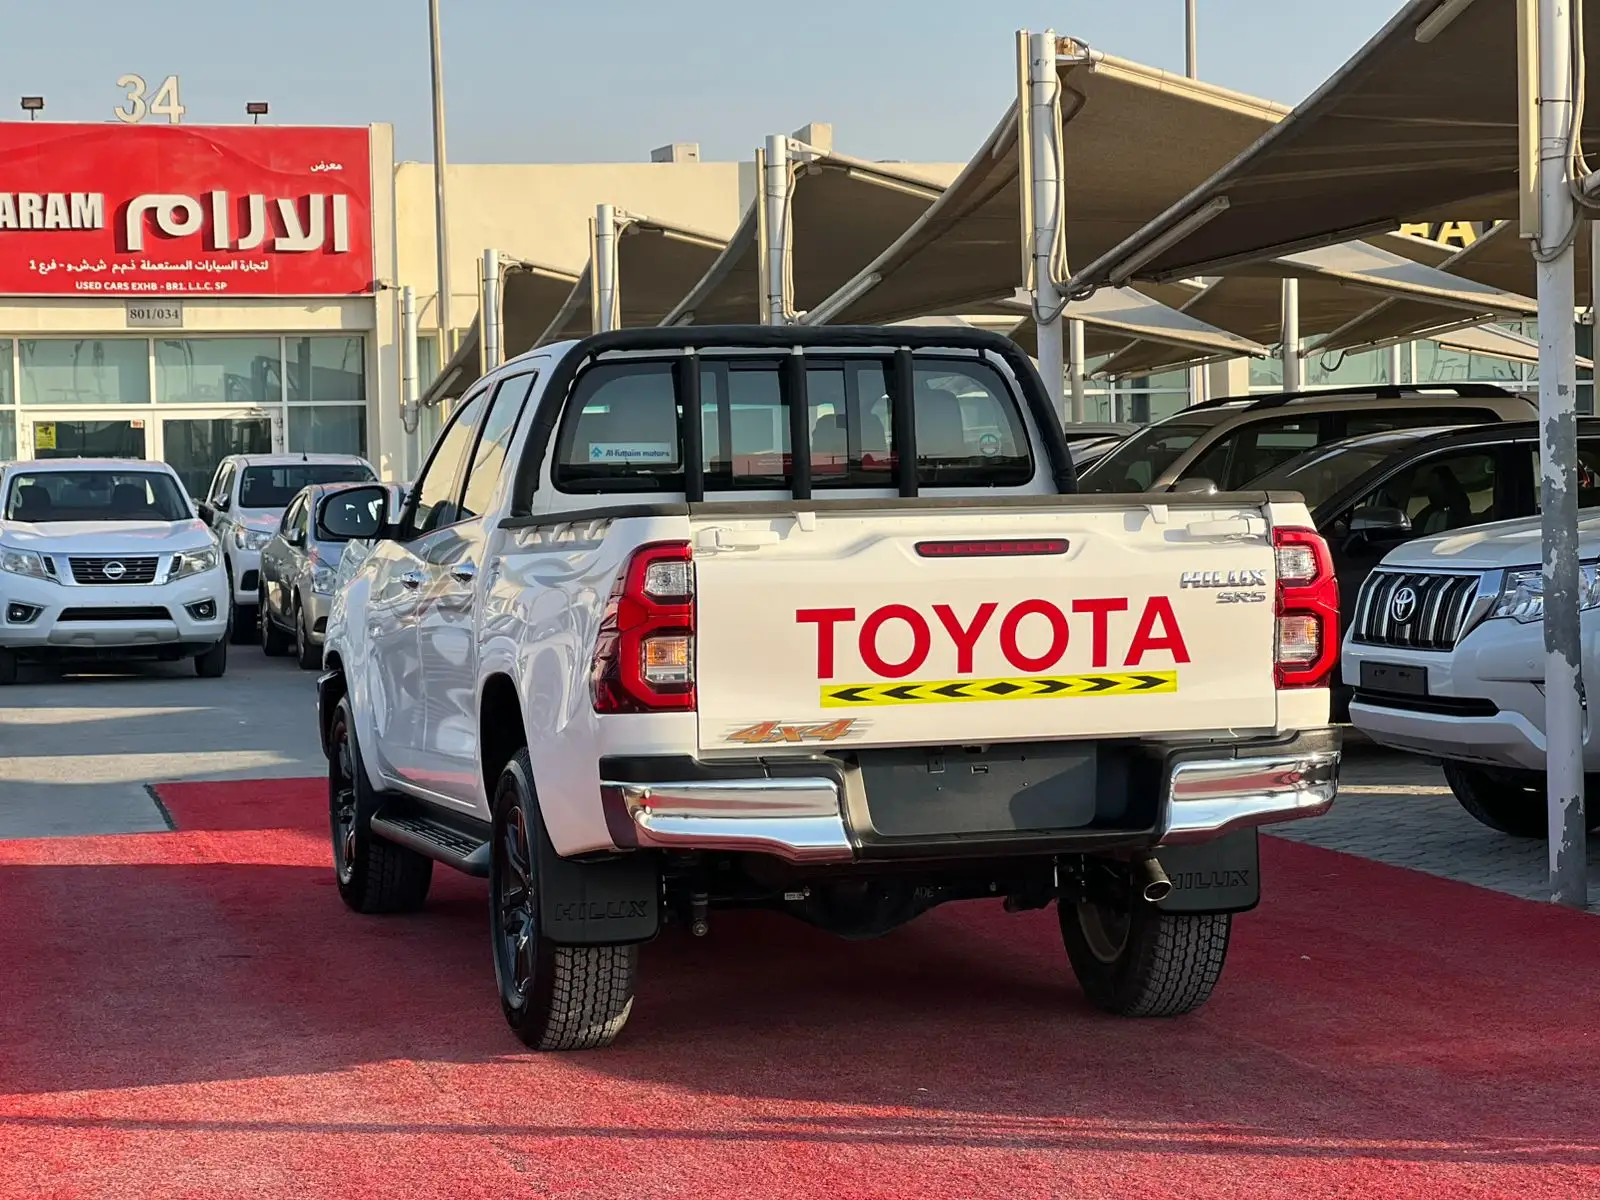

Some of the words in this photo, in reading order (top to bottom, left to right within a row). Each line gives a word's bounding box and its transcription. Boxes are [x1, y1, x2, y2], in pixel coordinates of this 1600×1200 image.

[113, 73, 185, 124] 34
[310, 160, 343, 172] معرض
[0, 192, 104, 229] ARAM
[29, 259, 37, 270] 1
[39, 258, 57, 274] فرع
[140, 259, 193, 271] المستعملة
[195, 259, 238, 273] السيارات
[240, 259, 269, 272] لتجارة
[75, 281, 102, 290] USED
[103, 281, 130, 290] CARS
[131, 281, 158, 291] EXHB
[214, 282, 228, 290] SP
[129, 308, 180, 320] 801/034
[1180, 569, 1266, 589] HILUX
[796, 596, 1191, 679] TOYOTA
[554, 900, 648, 921] HILUX
